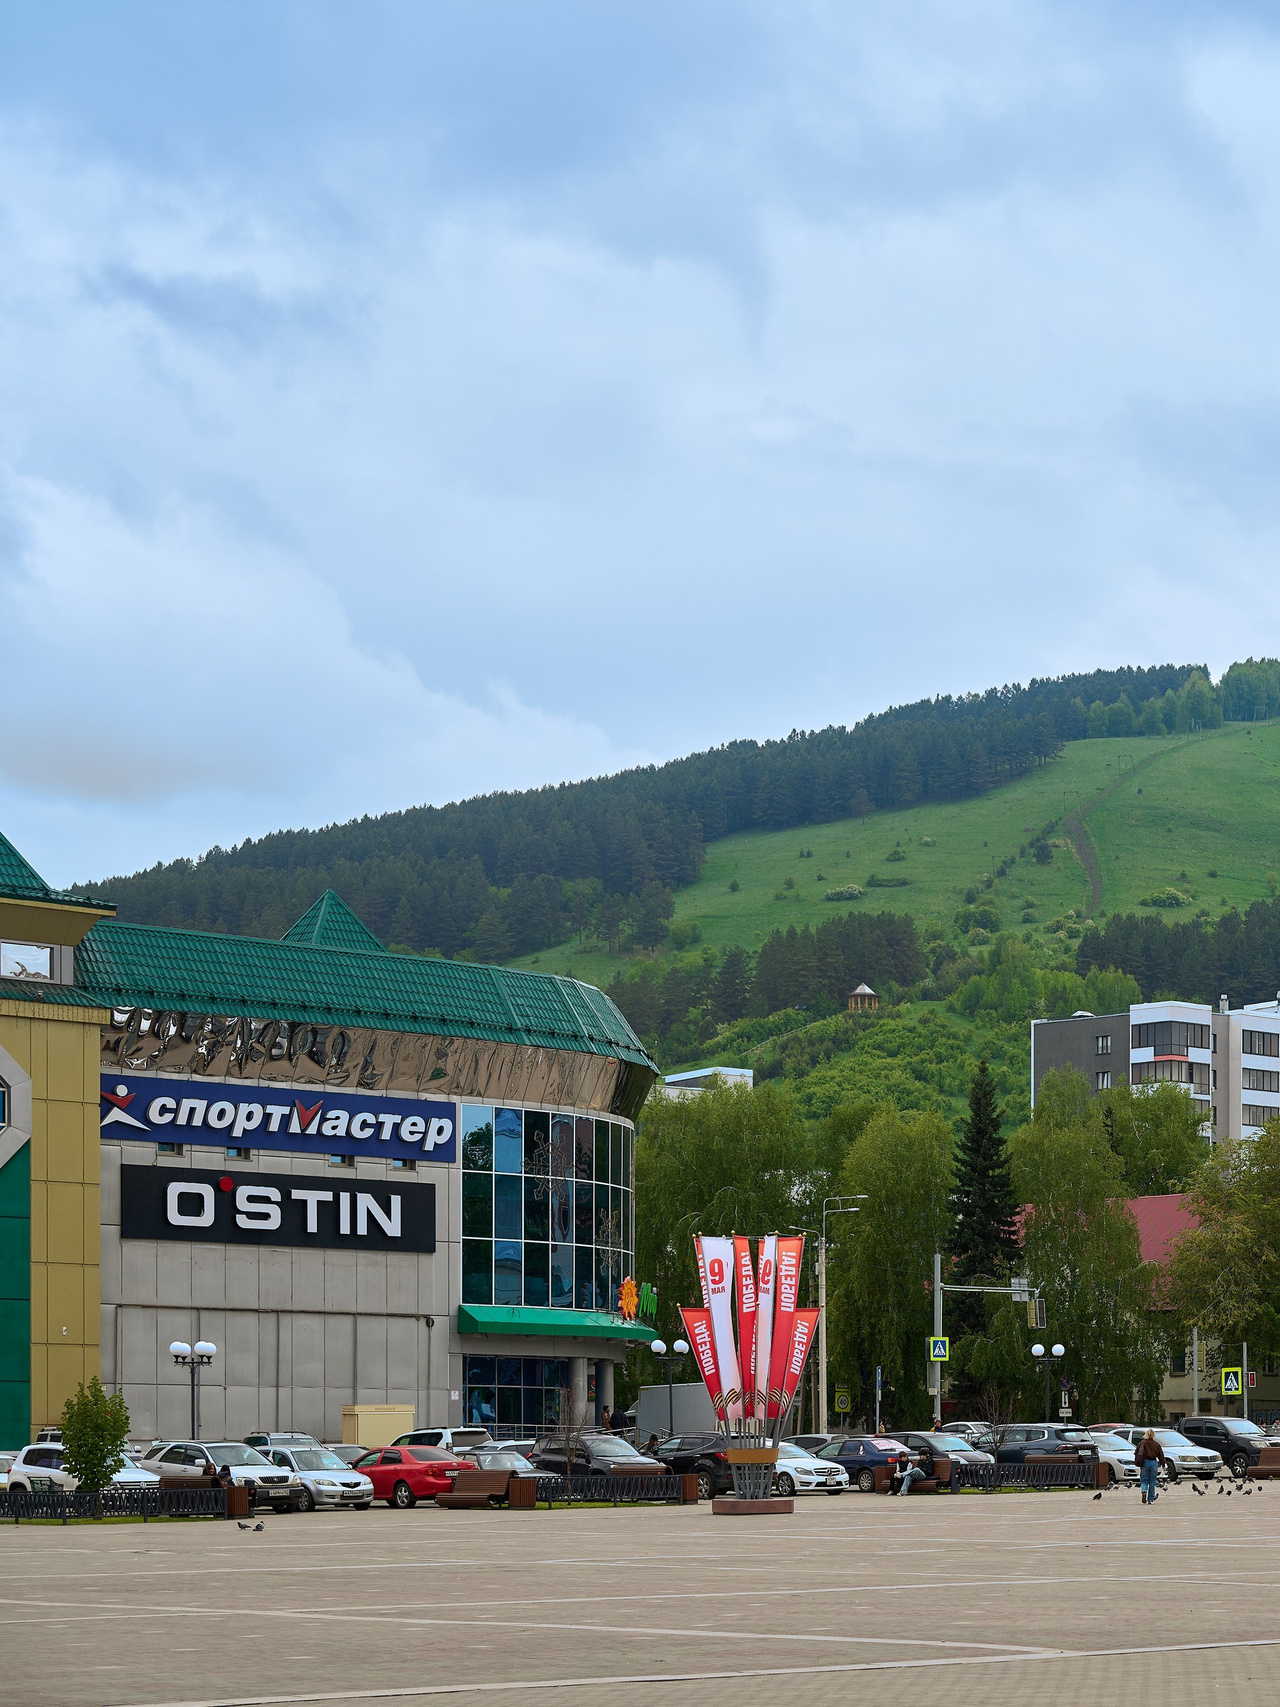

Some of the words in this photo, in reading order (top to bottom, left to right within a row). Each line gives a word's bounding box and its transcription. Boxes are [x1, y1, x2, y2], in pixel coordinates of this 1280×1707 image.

[146, 1096, 453, 1152] спортмастер
[709, 1258, 725, 1285] 9
[711, 1286, 726, 1295] МАЯ
[741, 1251, 756, 1314] ПОБЕДА!
[693, 1320, 716, 1376] ПОБЕДА!
